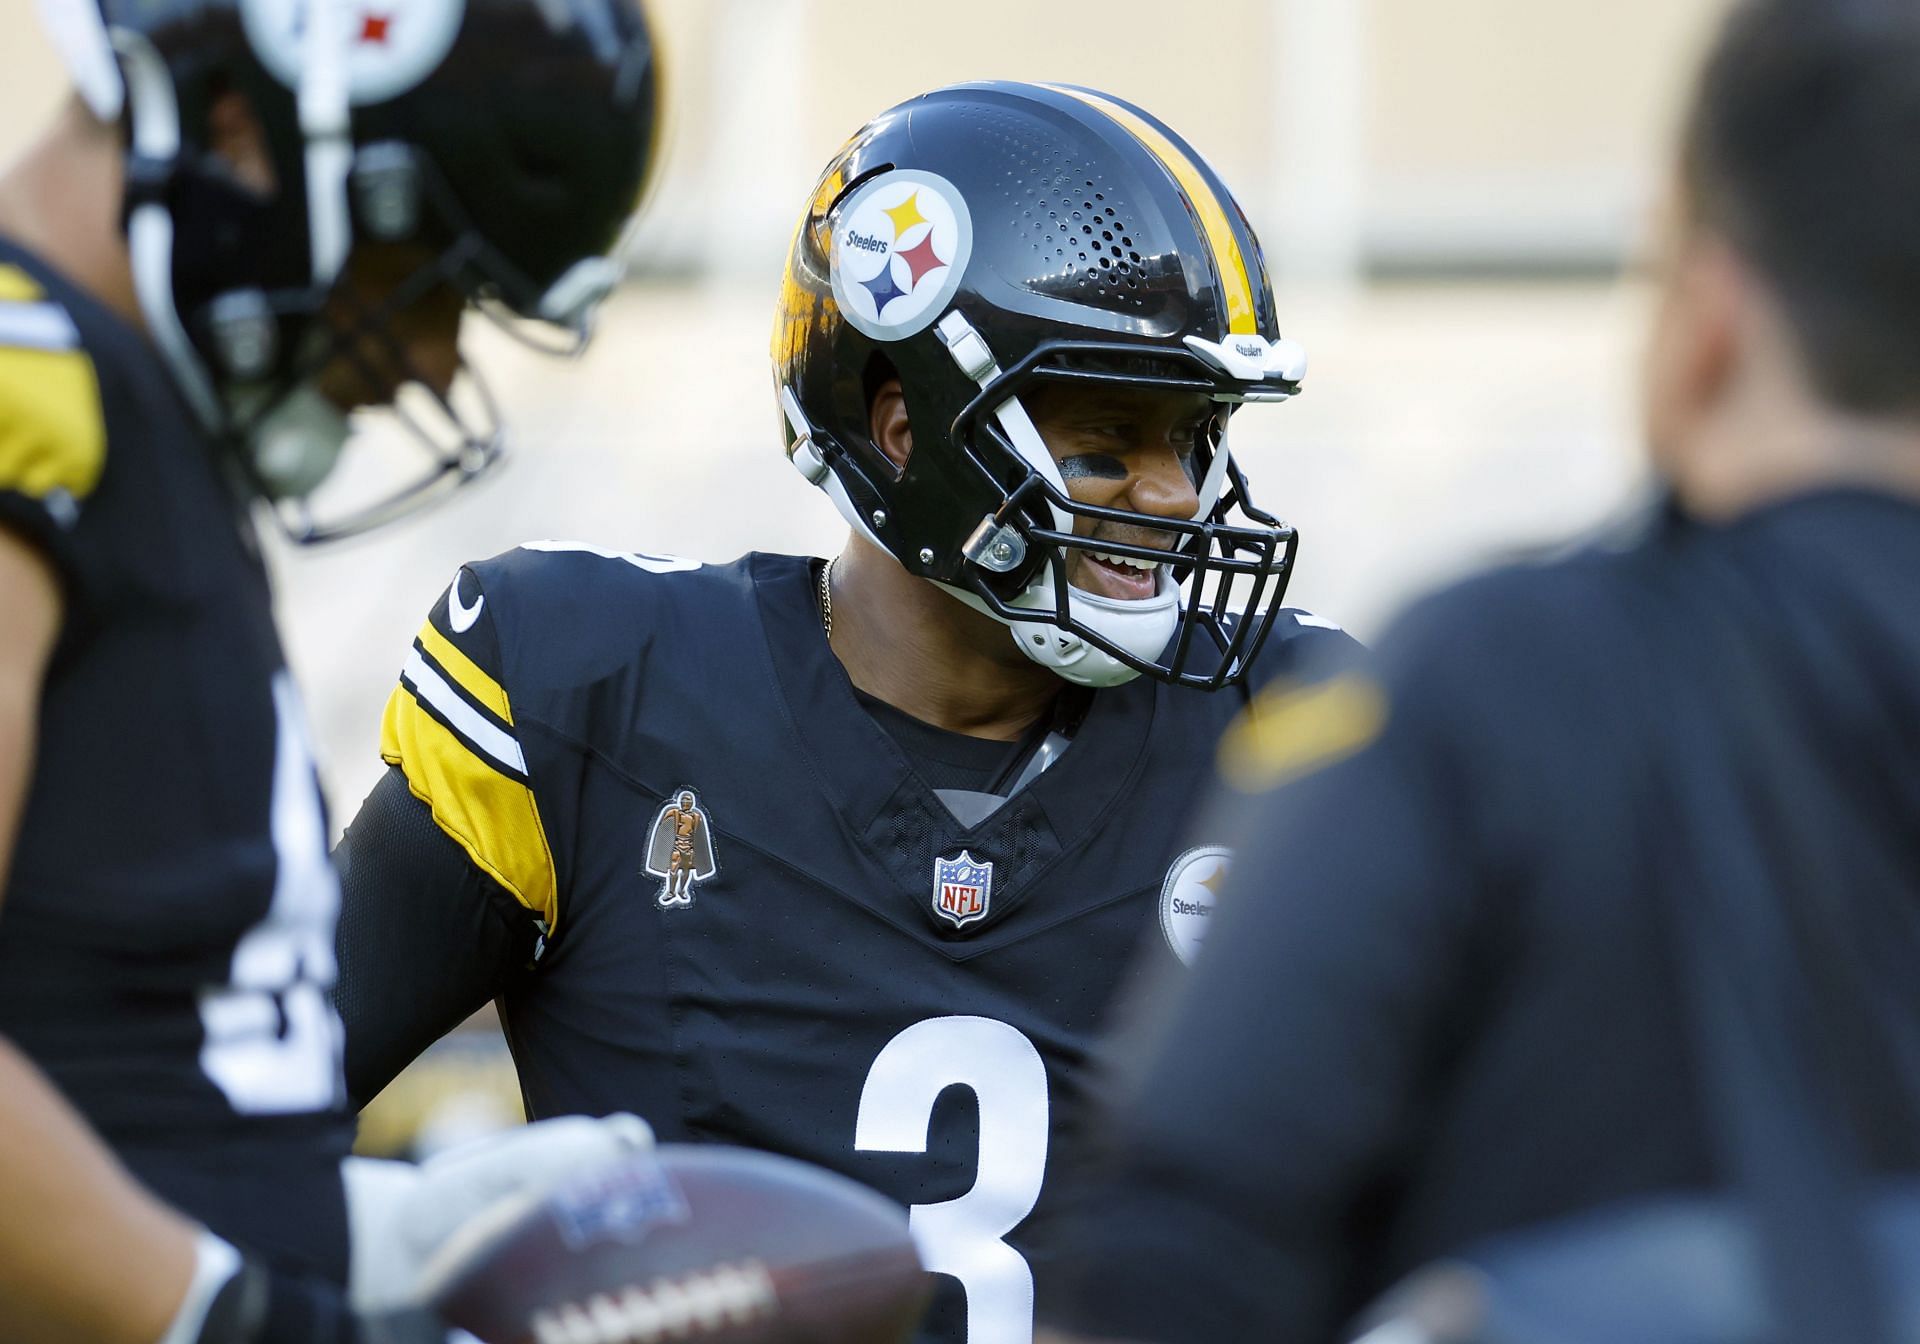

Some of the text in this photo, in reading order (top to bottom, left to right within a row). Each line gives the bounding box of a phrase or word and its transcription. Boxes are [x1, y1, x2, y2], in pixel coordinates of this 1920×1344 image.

[846, 230, 888, 254] Steelers
[942, 885, 980, 914] NFL
[855, 1015, 1049, 1344] 3
